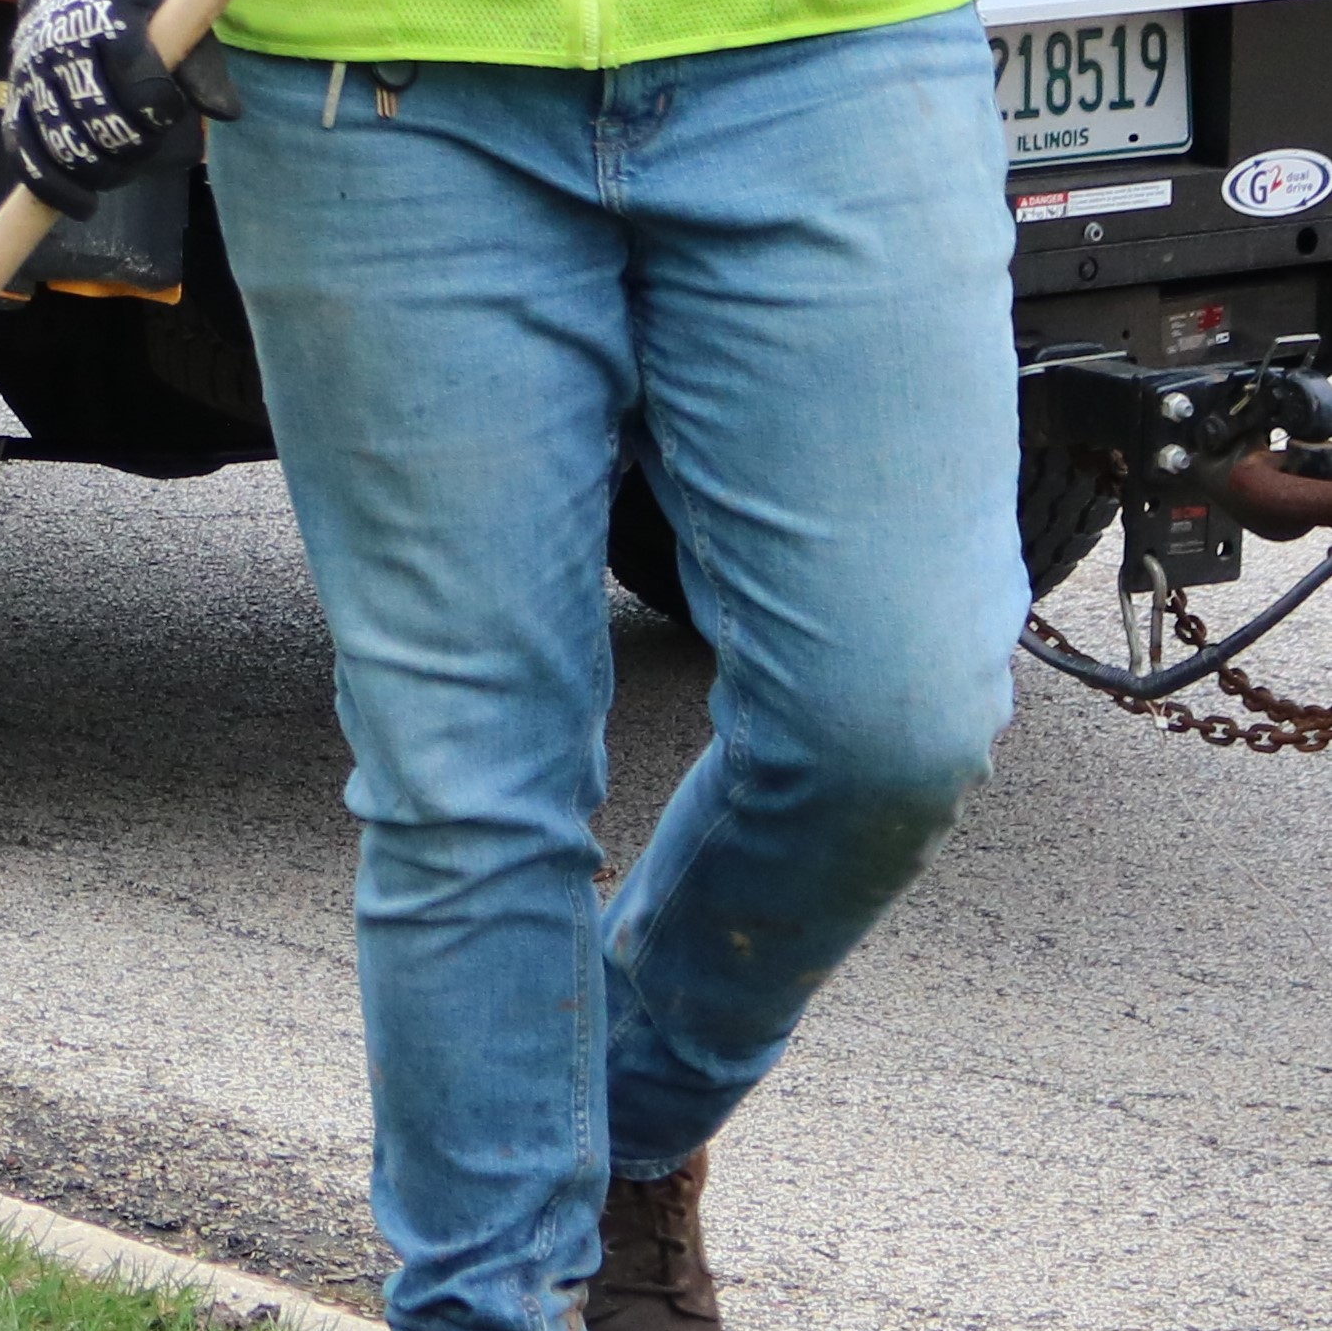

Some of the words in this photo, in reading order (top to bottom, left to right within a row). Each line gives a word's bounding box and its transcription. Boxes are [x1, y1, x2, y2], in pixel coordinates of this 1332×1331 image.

[1017, 128, 1089, 152] ILLINOIS
[1286, 170, 1310, 182] dual
[1286, 182, 1313, 194] drive
[1029, 193, 1065, 207] DANGER
